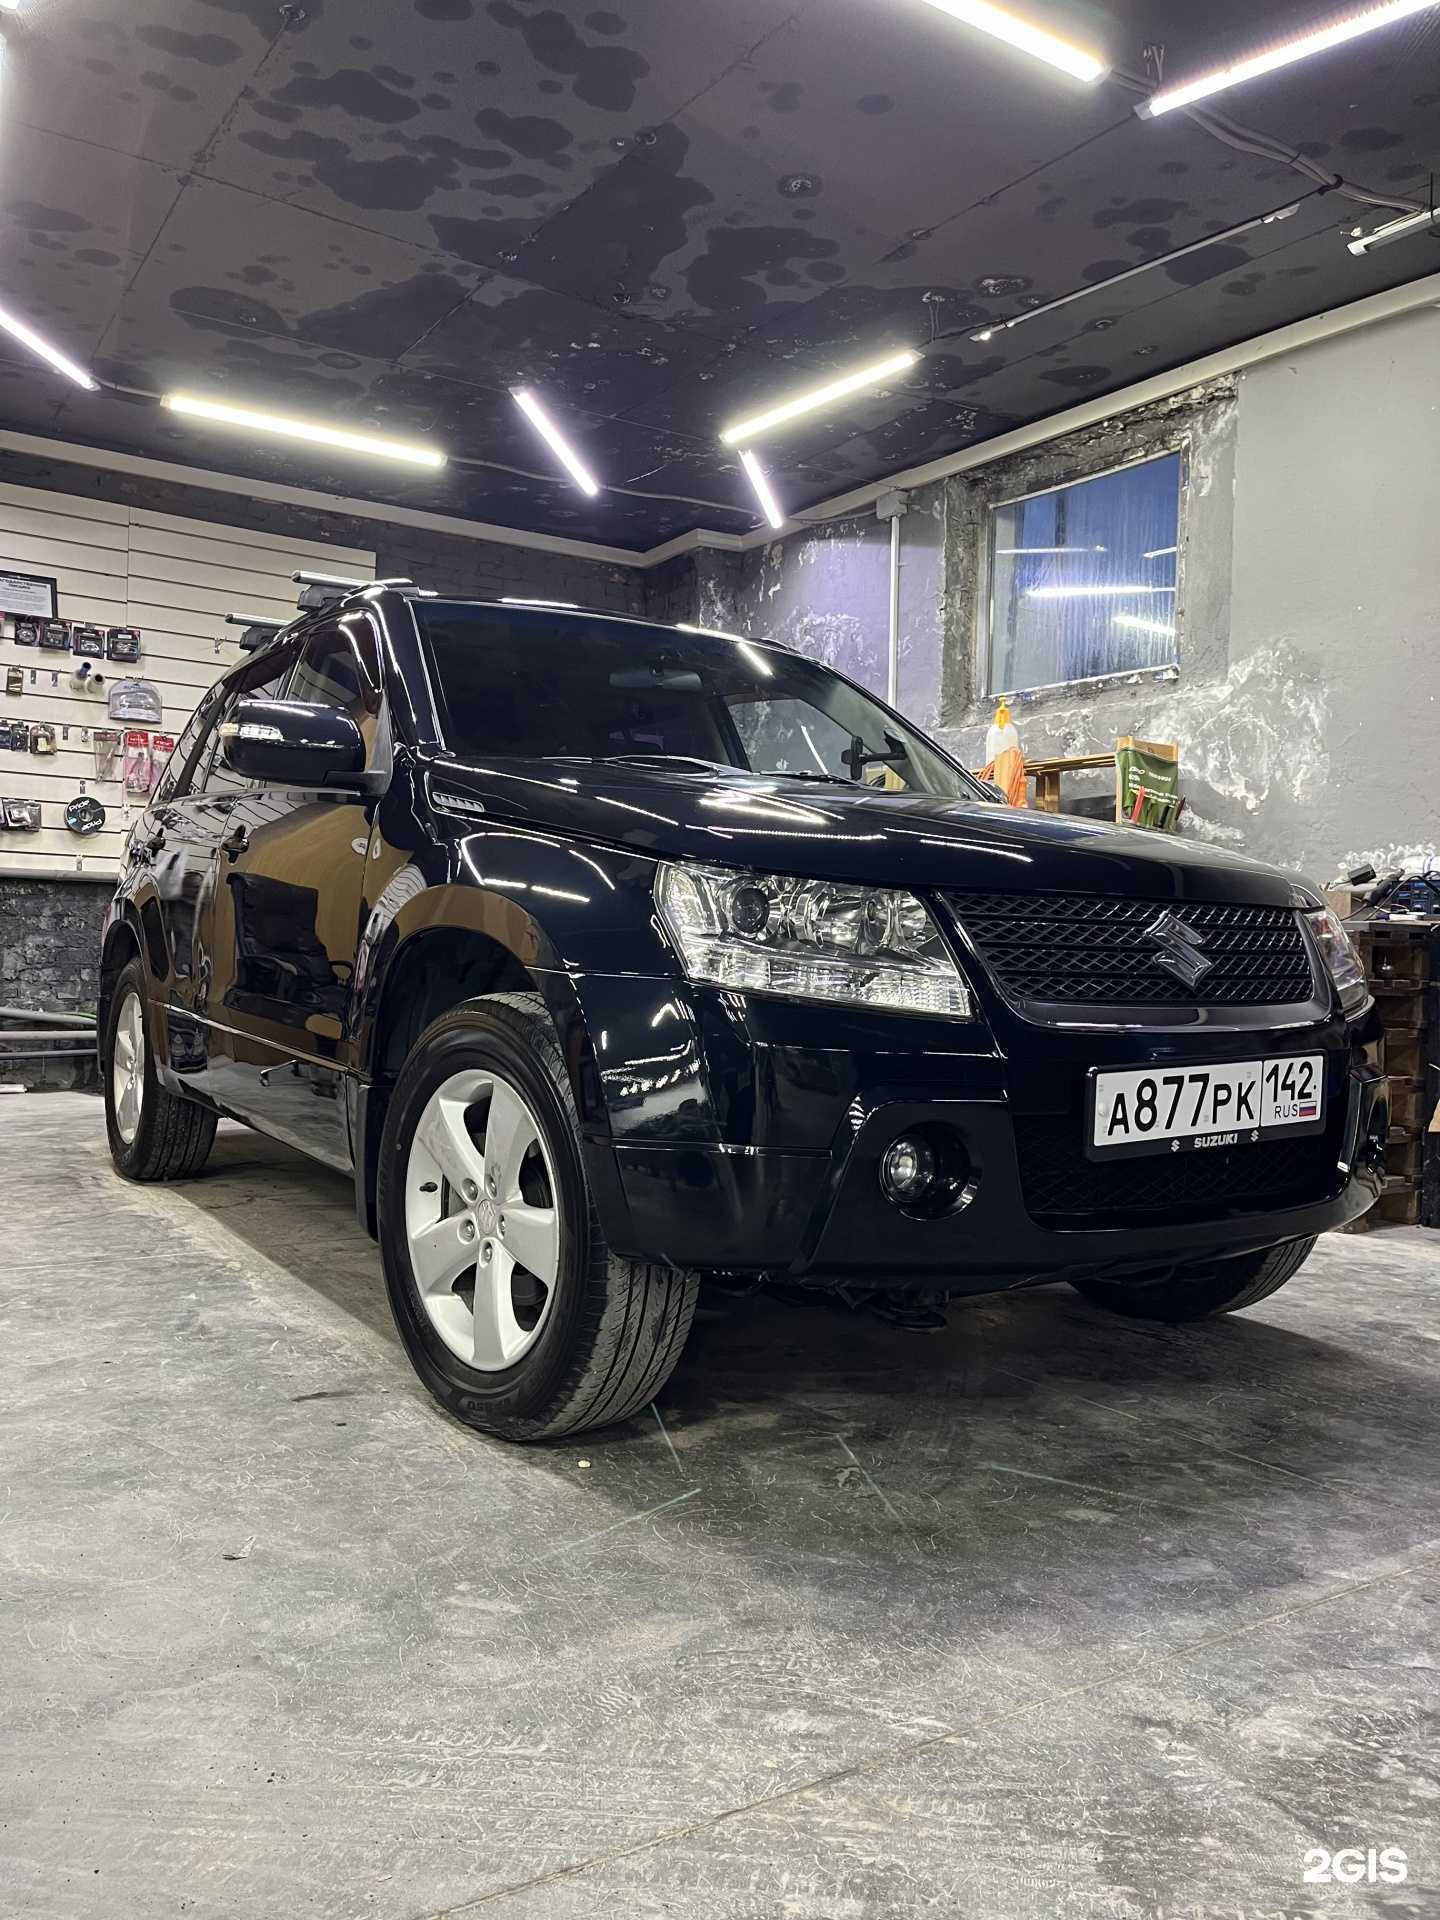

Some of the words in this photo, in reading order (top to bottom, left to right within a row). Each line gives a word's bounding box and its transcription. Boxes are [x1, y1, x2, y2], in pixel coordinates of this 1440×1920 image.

[1107, 1073, 1256, 1136] А877РК
[1265, 1061, 1313, 1102] 142
[1274, 1103, 1298, 1119] RUS
[1194, 1133, 1238, 1149] SUZUKI
